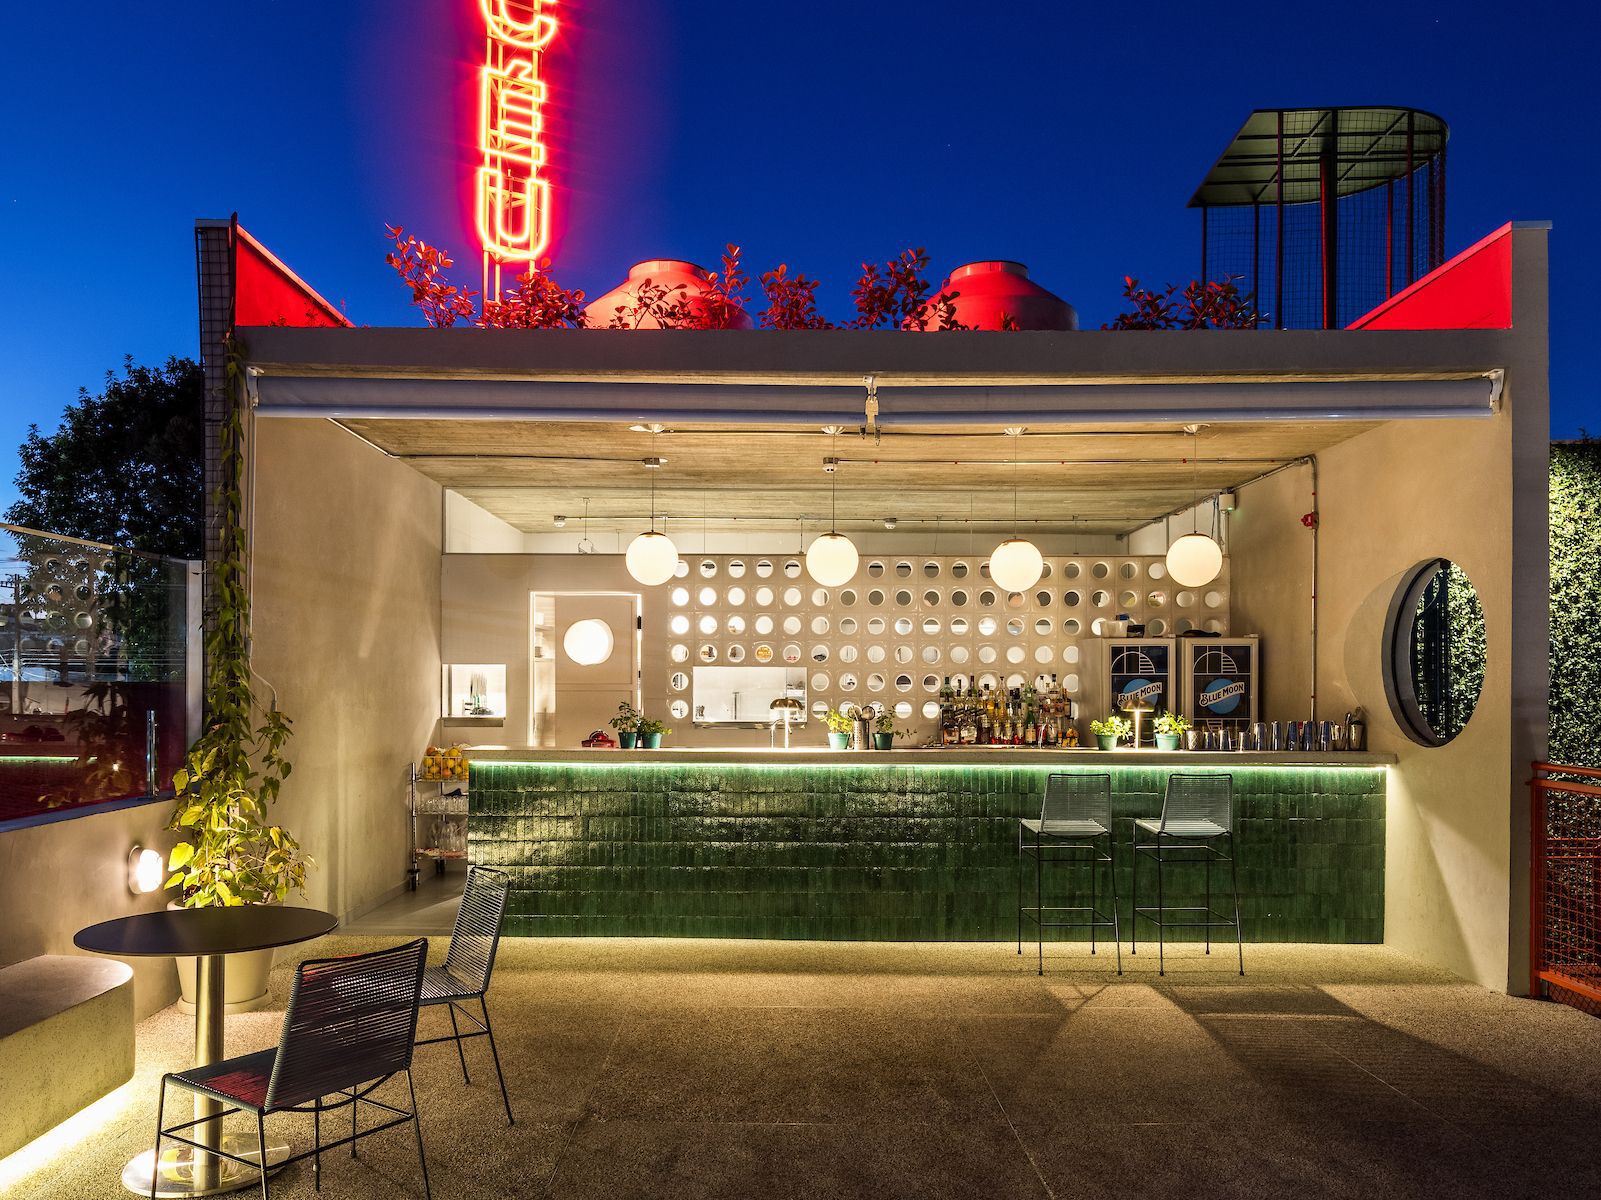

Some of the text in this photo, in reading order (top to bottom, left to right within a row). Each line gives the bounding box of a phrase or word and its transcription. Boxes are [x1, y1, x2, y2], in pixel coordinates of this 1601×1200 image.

[1140, 684, 1161, 697] MOON
[1200, 684, 1244, 706] BLUE MOON
